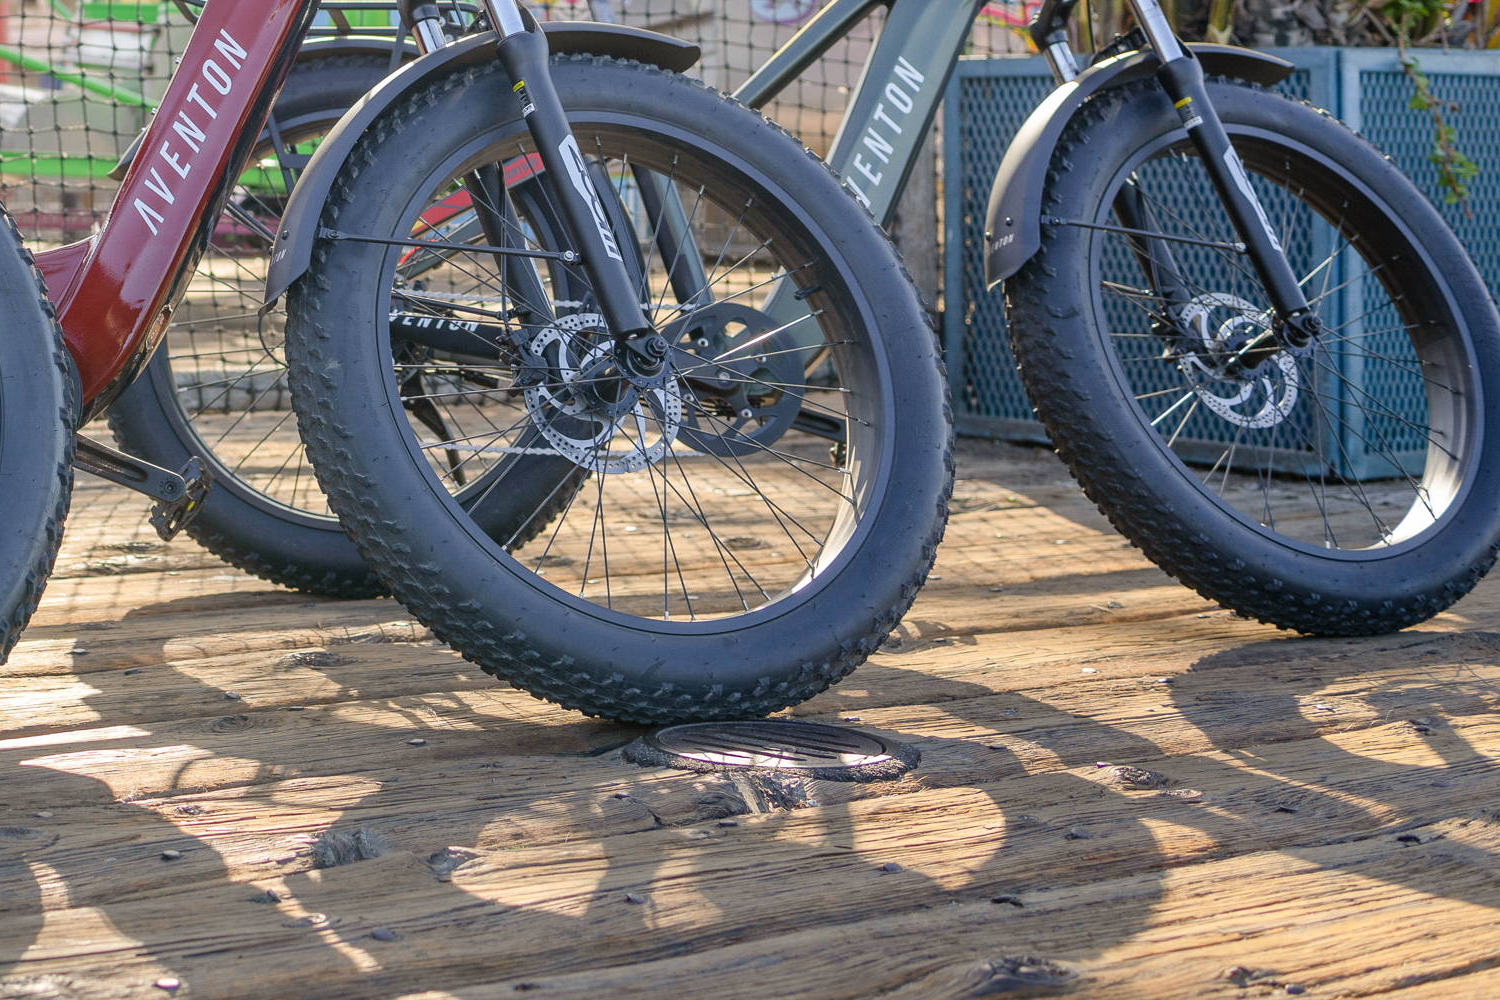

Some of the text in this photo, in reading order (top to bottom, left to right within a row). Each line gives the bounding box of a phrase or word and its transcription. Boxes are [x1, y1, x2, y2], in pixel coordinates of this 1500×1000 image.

[133, 28, 248, 236] AVENTON
[846, 55, 925, 209] VENTON
[389, 309, 479, 333] VENTON
